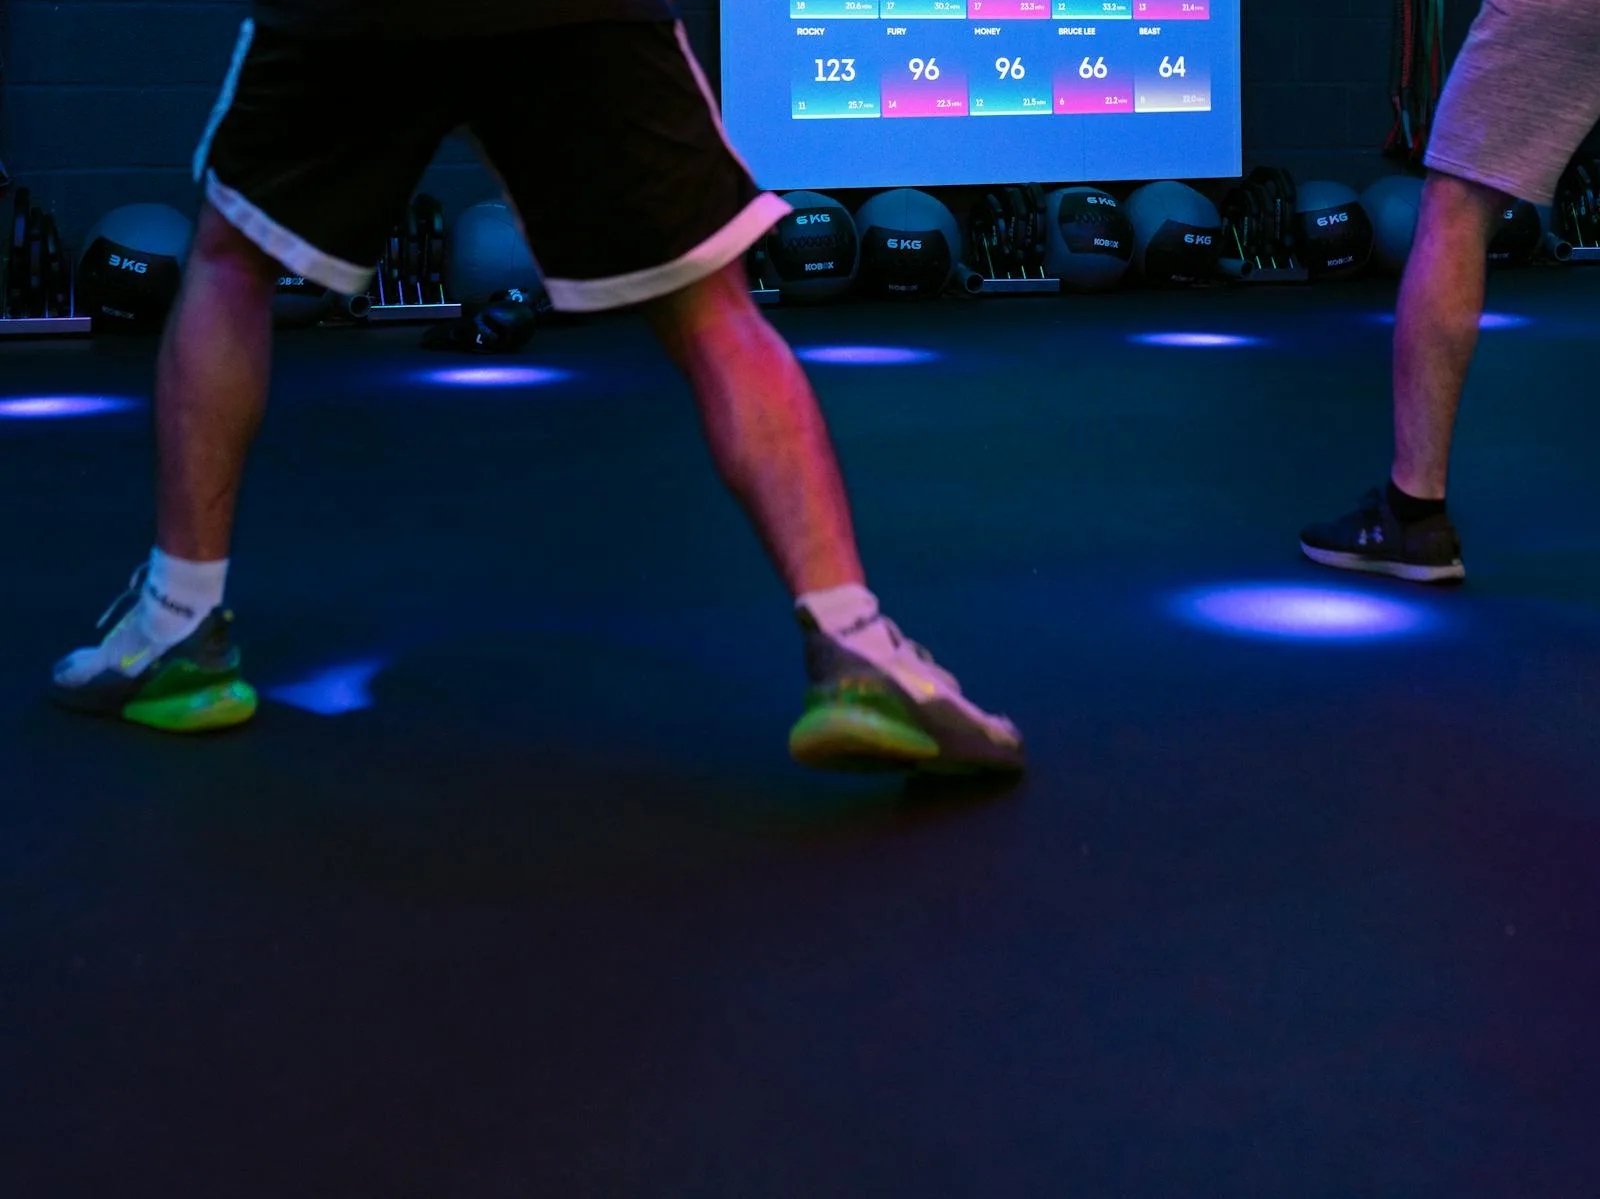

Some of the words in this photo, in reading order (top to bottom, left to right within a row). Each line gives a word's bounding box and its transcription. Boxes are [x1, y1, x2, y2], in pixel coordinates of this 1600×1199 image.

[796, 27, 825, 36] ROCKY
[887, 27, 907, 36] FURY
[974, 27, 1001, 36] MONEY
[1058, 27, 1083, 36] BRUCE
[1084, 27, 1096, 36] LEE
[1138, 27, 1161, 36] BEAST
[815, 58, 856, 82] 123
[908, 57, 940, 81] 96
[995, 56, 1026, 80] 96
[1079, 56, 1108, 79] 66
[1158, 55, 1186, 78] 64
